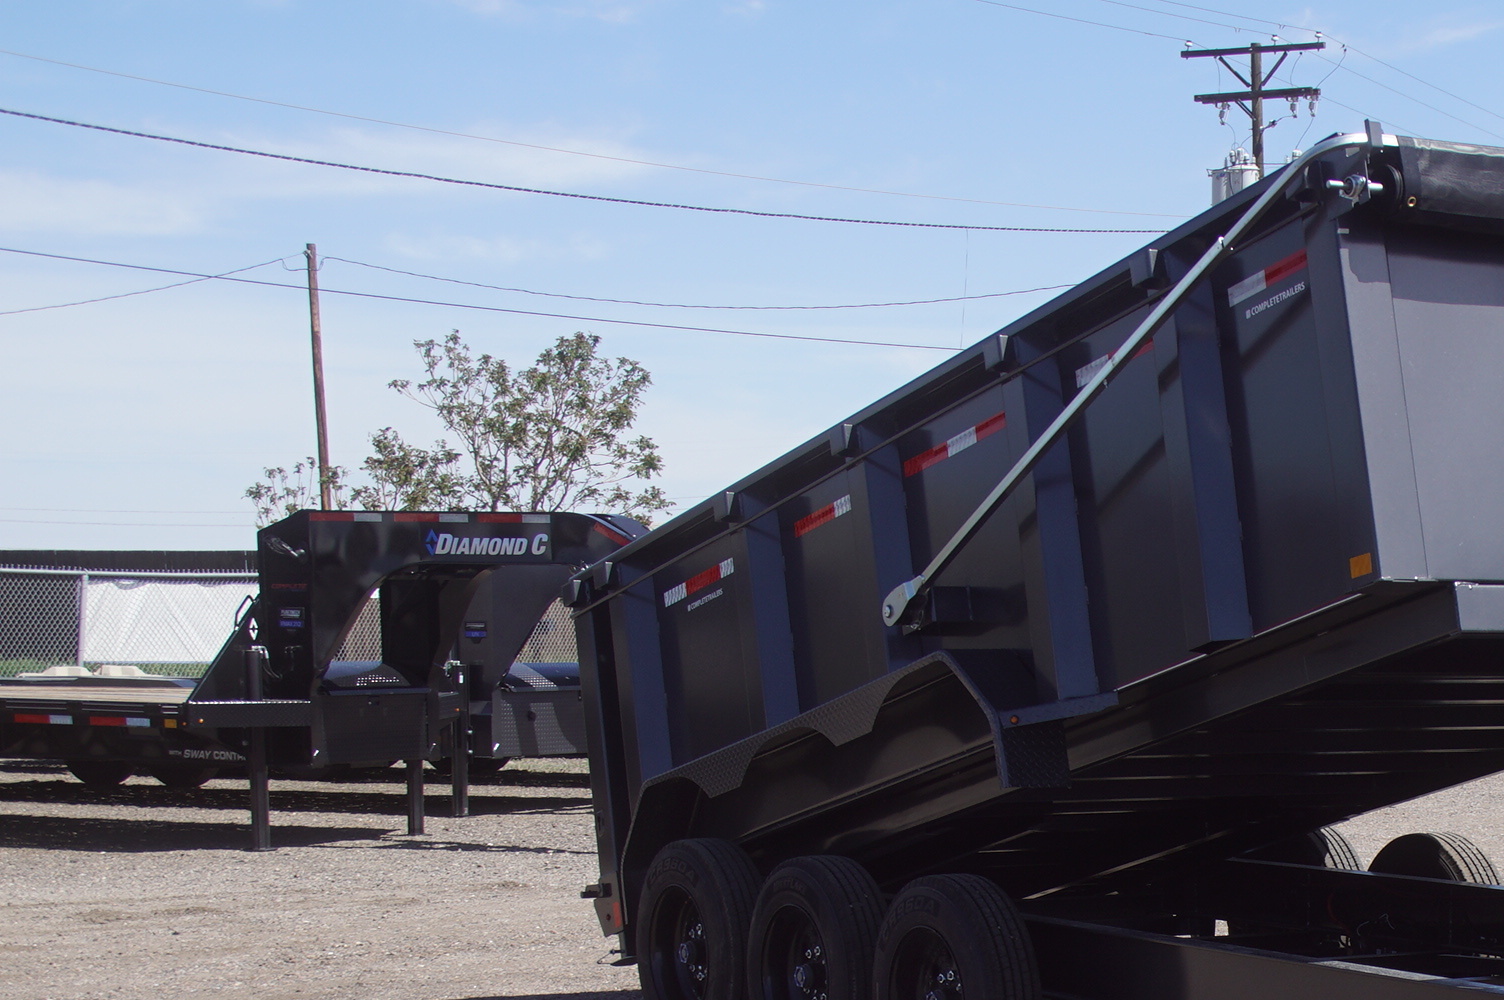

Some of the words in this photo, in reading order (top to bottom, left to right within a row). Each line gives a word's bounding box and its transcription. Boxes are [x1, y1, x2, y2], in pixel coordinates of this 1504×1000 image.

[1250, 281, 1306, 316] COMPLETETRAILERS
[435, 533, 528, 556] DIAMOND
[531, 533, 549, 556] C
[183, 748, 212, 760] SWAY
[213, 750, 248, 761] CONTR
